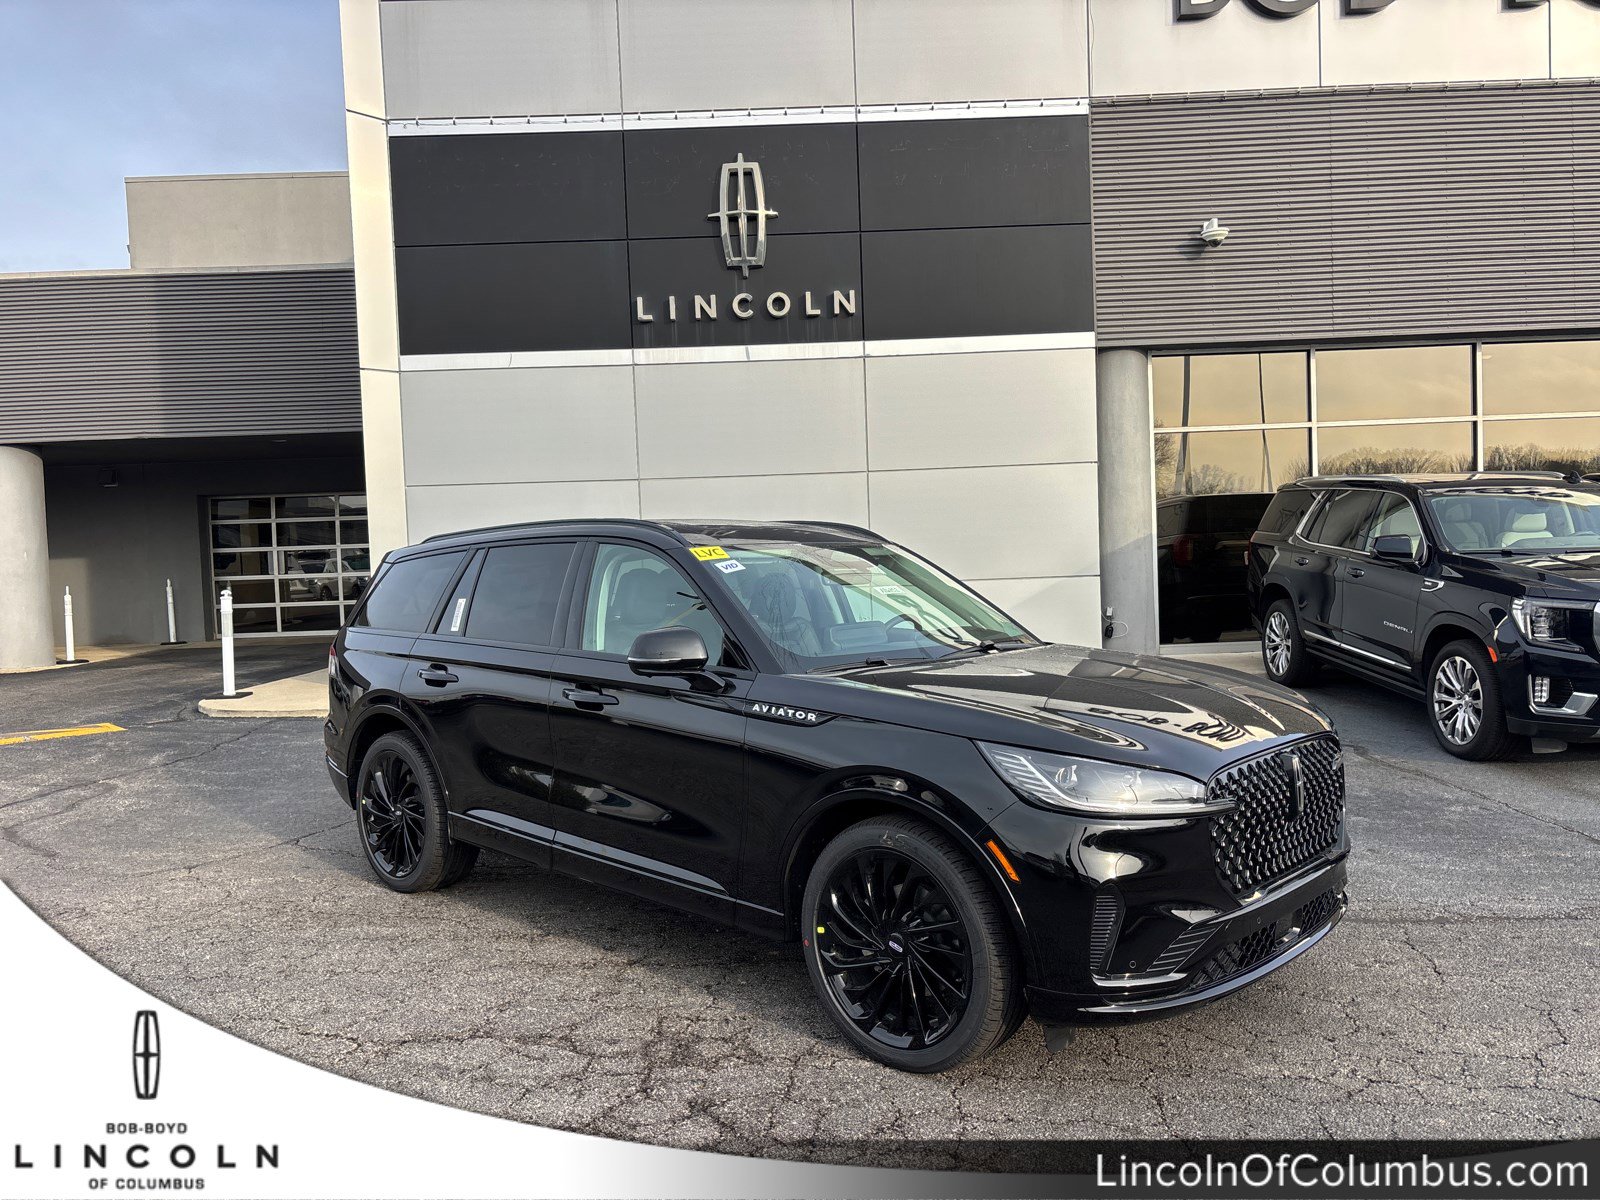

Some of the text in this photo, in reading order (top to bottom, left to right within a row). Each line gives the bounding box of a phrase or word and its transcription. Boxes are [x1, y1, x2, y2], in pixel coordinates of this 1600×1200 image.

[636, 289, 856, 323] LINCOLN
[693, 547, 725, 558] LVC
[1383, 620, 1413, 635] DENALI
[752, 703, 817, 722] AVIATOR
